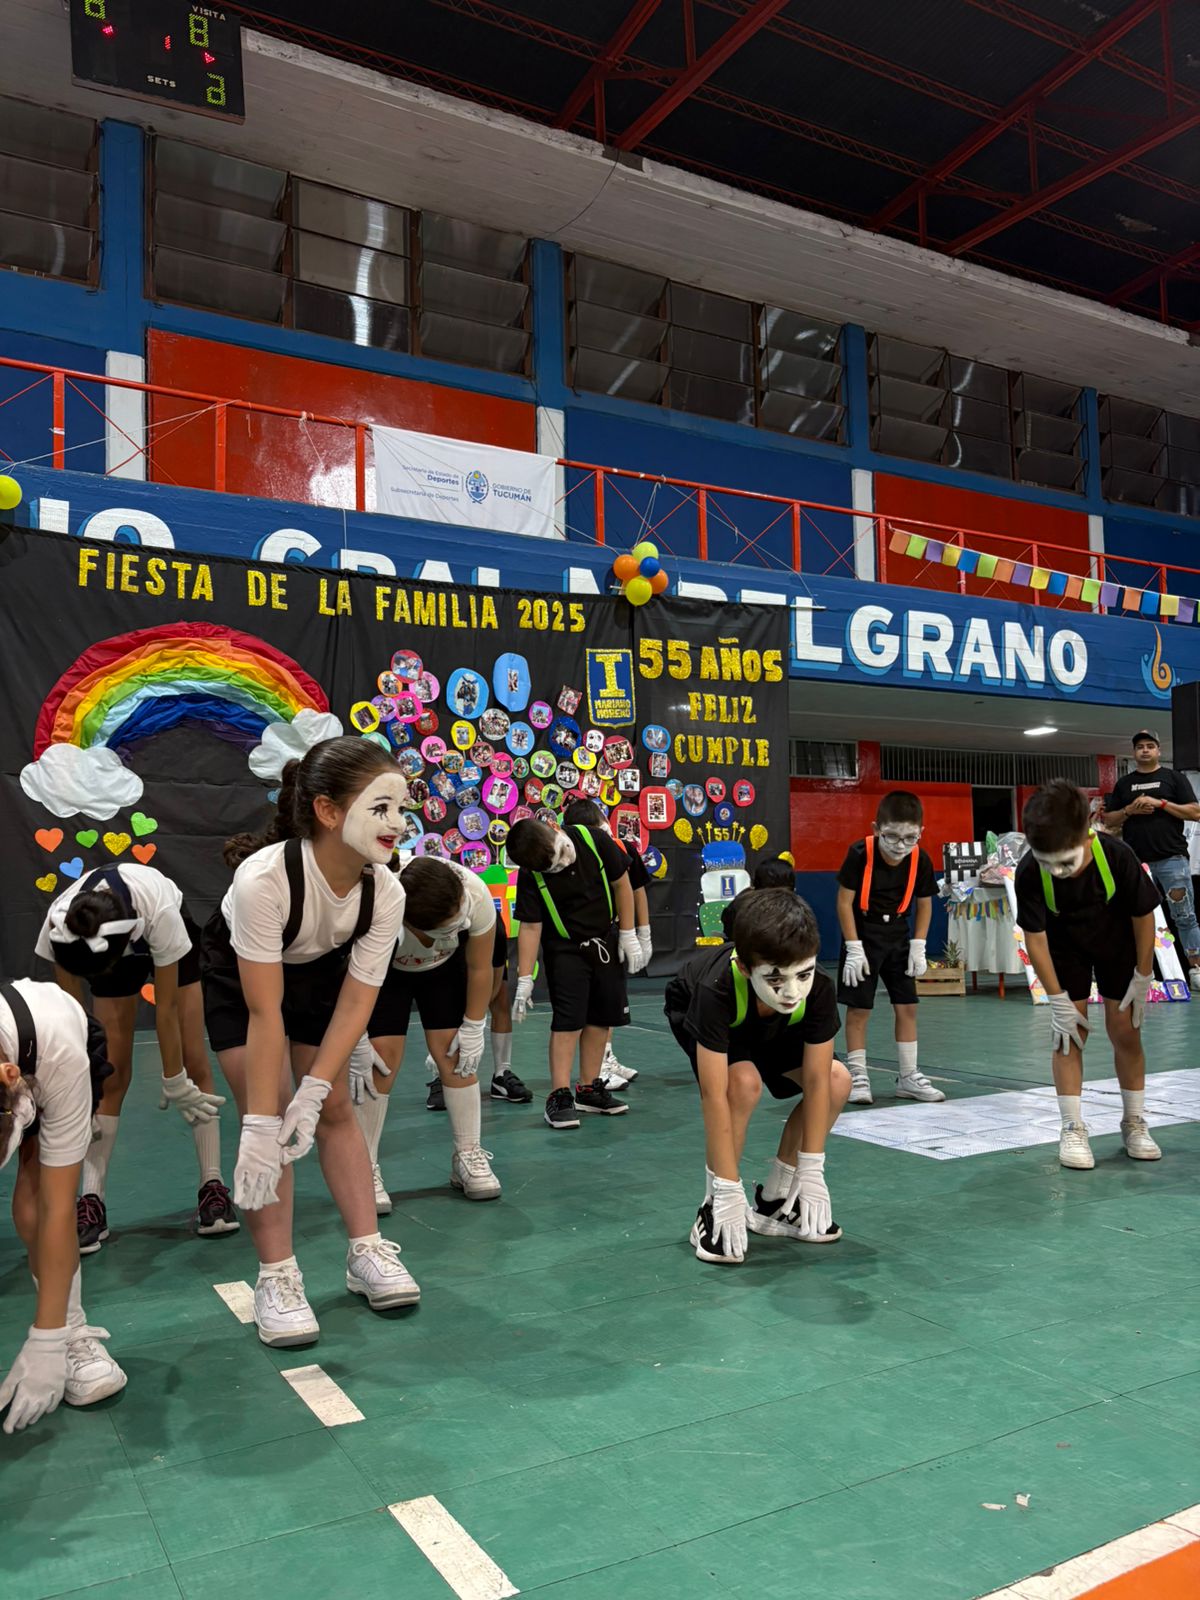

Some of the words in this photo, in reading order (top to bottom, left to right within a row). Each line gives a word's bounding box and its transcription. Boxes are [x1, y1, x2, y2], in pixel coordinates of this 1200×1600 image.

[192, 5, 226, 21] VISITA
[189, 13, 209, 48] 8
[147, 75, 176, 88] SETS
[427, 474, 459, 486] Deportes
[492, 482, 523, 493] GOBIERNO
[78, 547, 214, 602] FIESTA
[247, 570, 289, 611] DE
[318, 578, 353, 616] LA
[376, 585, 499, 630] FAMILIA
[517, 598, 586, 633] 2025
[638, 637, 693, 680] 55
[700, 636, 784, 683] AÑOS
[687, 691, 758, 724] FELIZ
[674, 733, 770, 767] CUMPLE
[713, 827, 730, 841] 55
